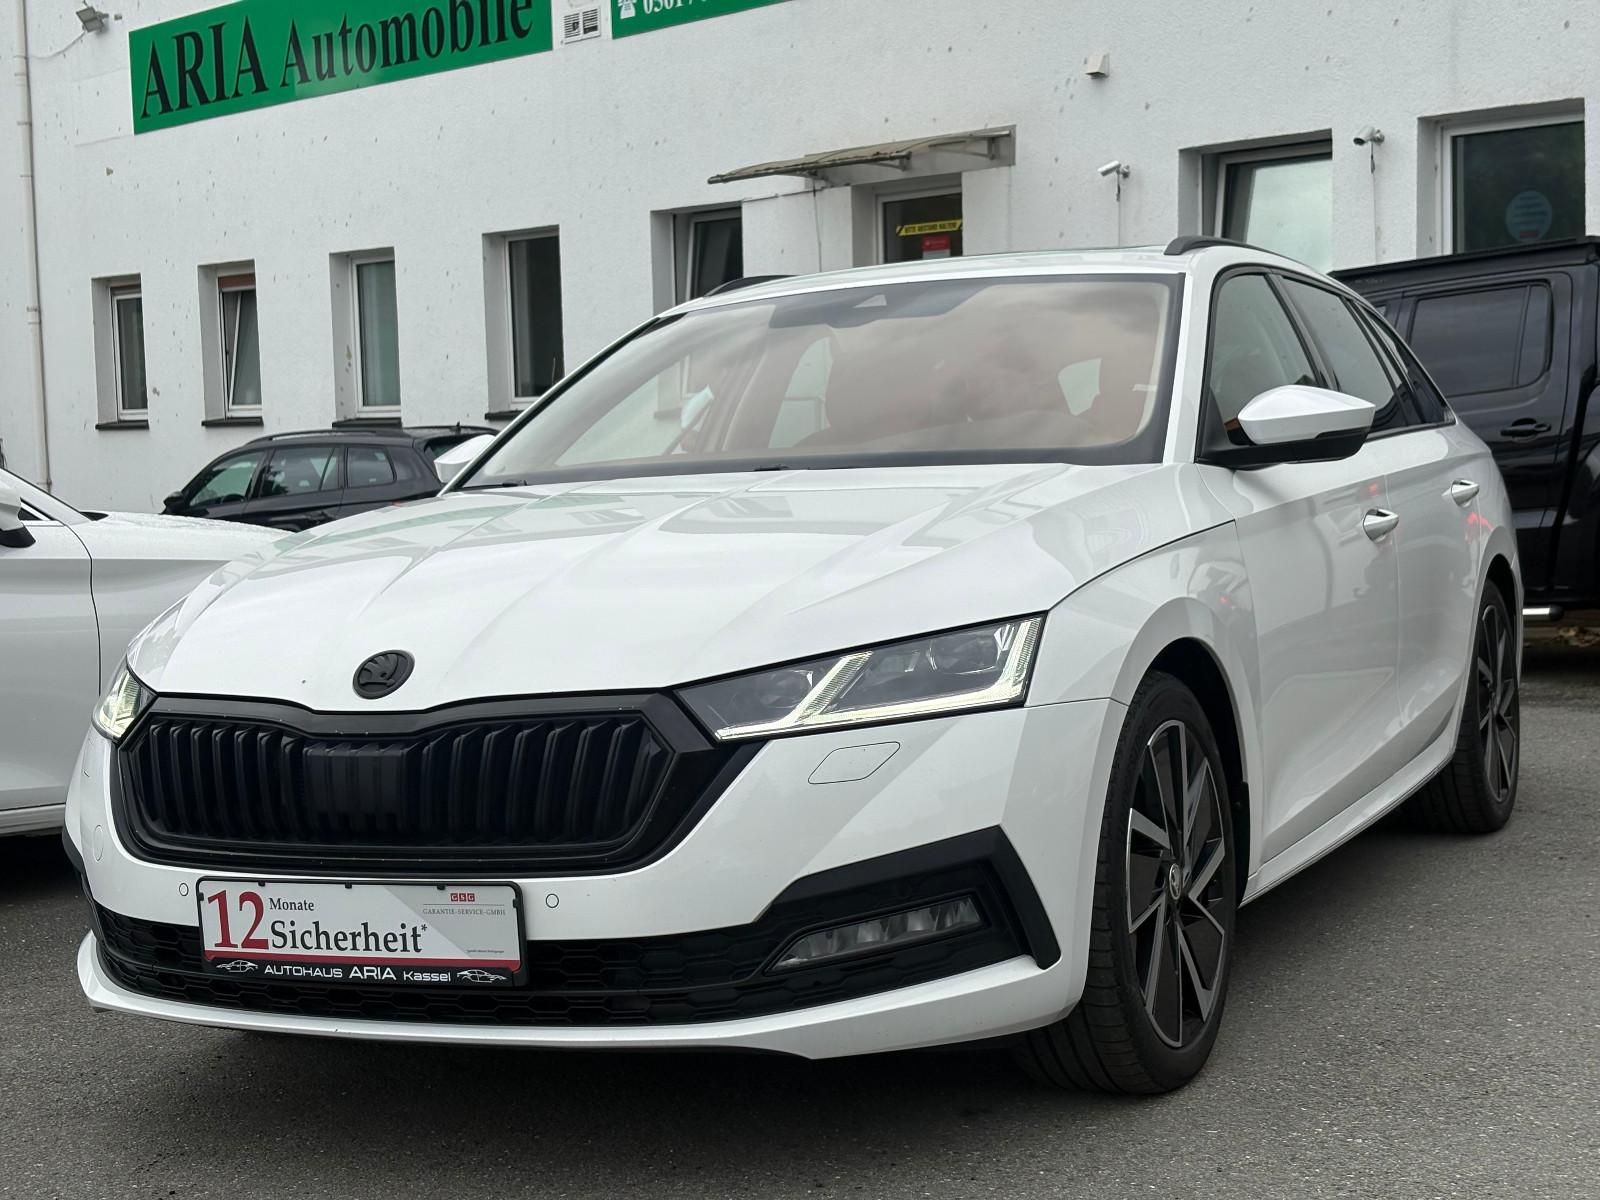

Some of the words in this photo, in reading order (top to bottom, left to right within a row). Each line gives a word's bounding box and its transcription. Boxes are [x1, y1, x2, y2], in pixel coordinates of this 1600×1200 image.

[141, 15, 269, 119] ARIA
[269, 897, 315, 912] Monate
[451, 893, 475, 902] GSG
[207, 889, 270, 950] 12
[264, 964, 343, 978] AUTOHAUS
[349, 966, 397, 981] ARIA
[403, 970, 452, 982] Kassel
